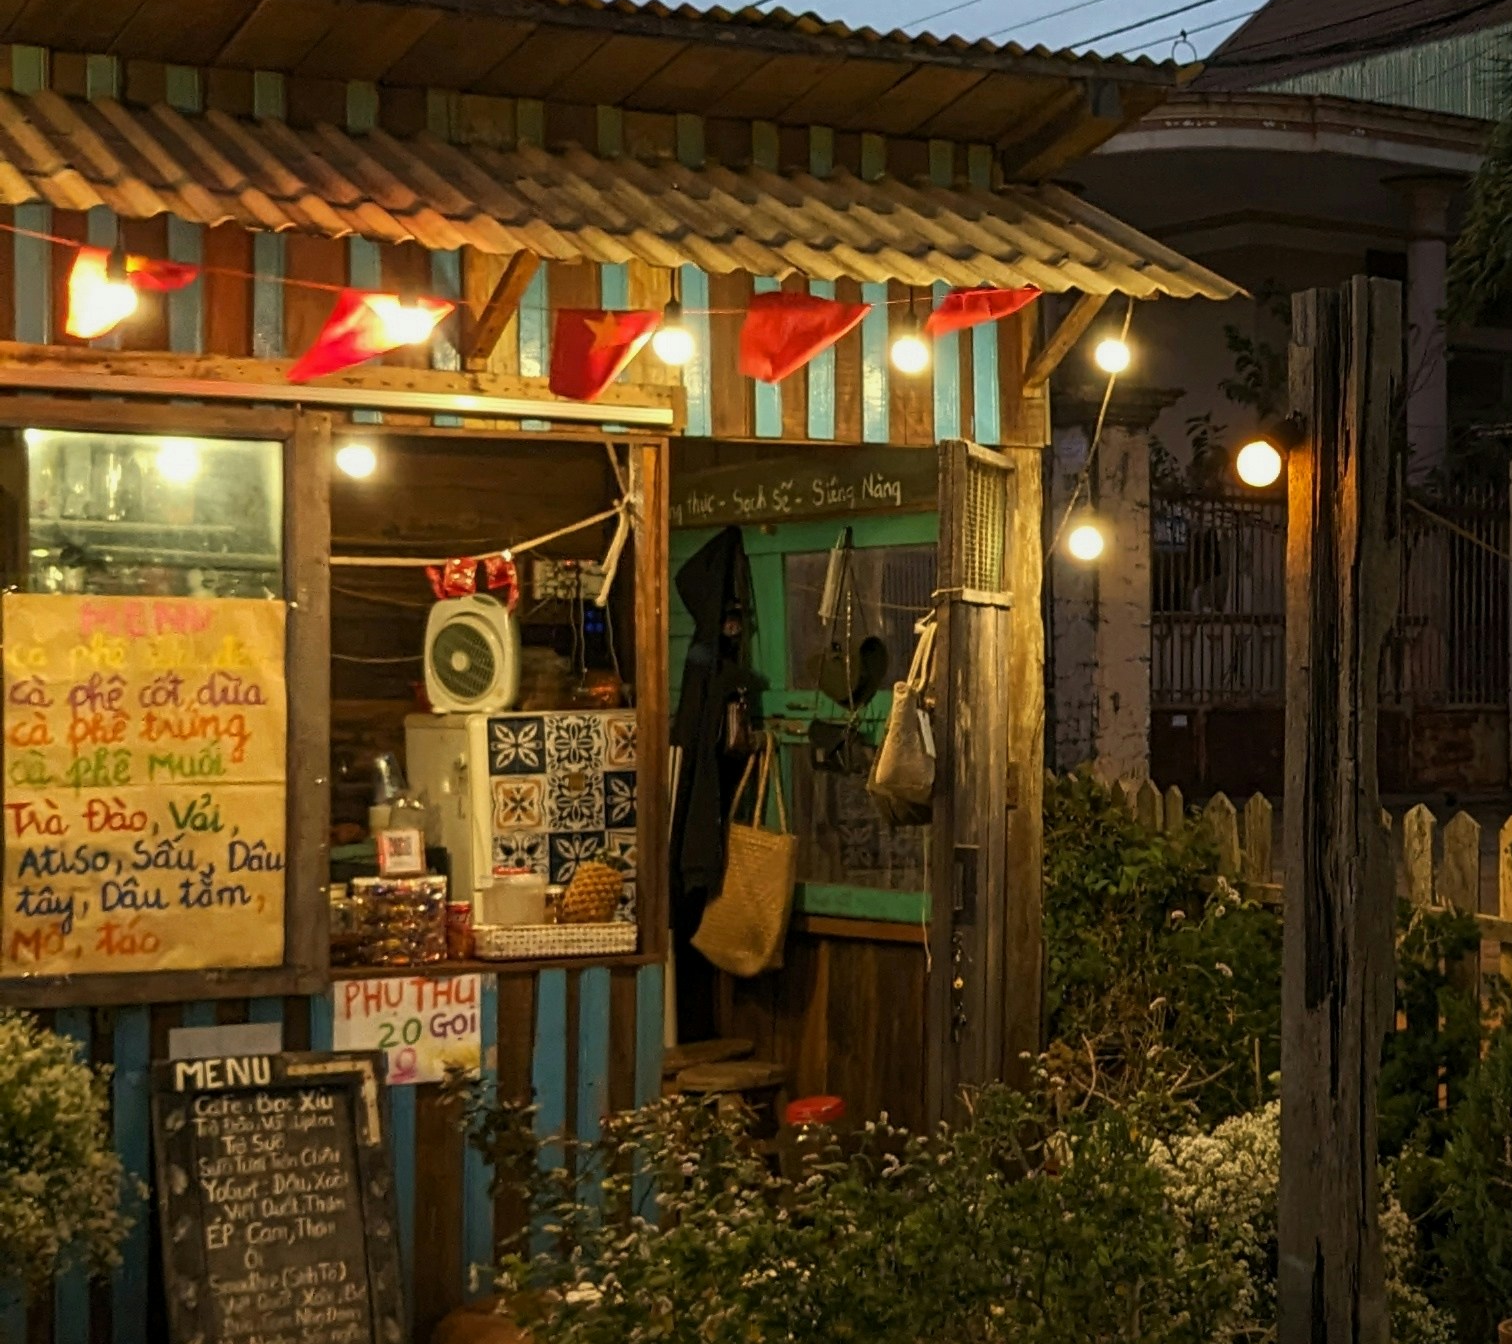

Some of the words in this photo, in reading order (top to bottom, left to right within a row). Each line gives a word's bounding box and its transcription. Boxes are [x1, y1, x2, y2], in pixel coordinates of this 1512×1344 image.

[68, 671, 128, 714] phê
[68, 711, 131, 757] phê
[66, 746, 132, 794] phê
[4, 798, 69, 839] Trà
[100, 876, 170, 912] Dâu
[95, 916, 161, 955] táo
[344, 980, 404, 1020] PHỤ
[377, 1018, 423, 1049] 20
[175, 1056, 272, 1092] MENU
